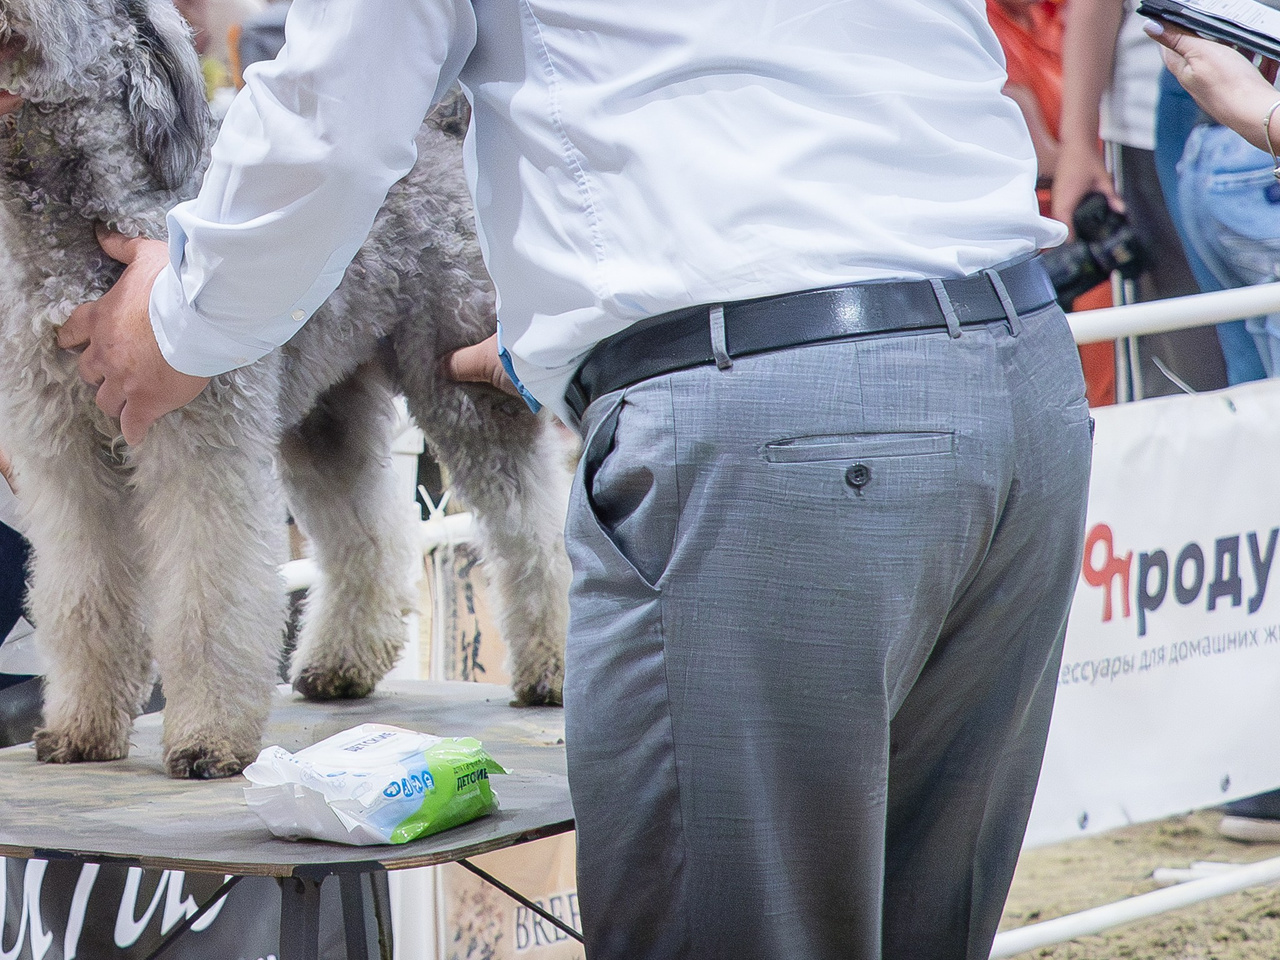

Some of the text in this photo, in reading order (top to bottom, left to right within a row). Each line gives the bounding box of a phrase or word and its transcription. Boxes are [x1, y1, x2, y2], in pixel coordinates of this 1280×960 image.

[1057, 653, 1135, 686] ессуары
[1139, 644, 1165, 672] для
[1168, 626, 1259, 664] домашних
